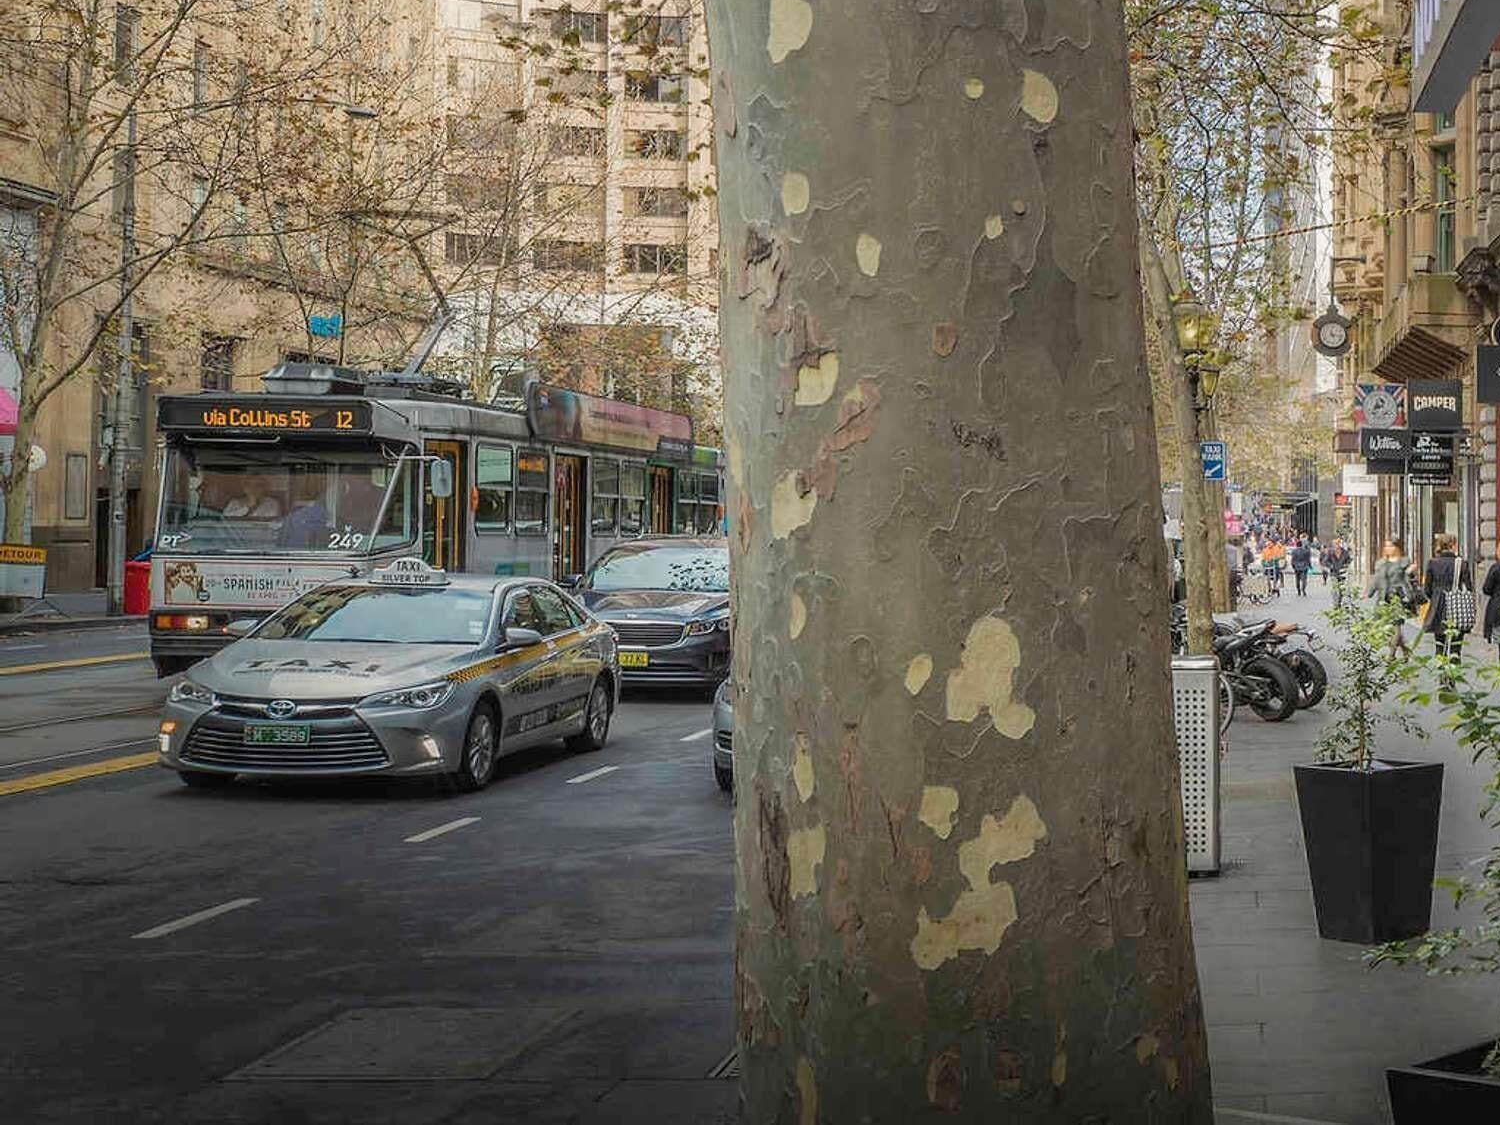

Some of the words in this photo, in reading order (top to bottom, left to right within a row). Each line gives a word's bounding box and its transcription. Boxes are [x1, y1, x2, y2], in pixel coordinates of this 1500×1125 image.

[1413, 396, 1456, 412] CAMPER
[203, 409, 226, 427] via
[229, 408, 286, 428] Collins
[290, 410, 311, 428] St
[336, 410, 353, 429] 12
[328, 533, 363, 550] 249
[0, 550, 41, 559] ETOUR
[396, 560, 421, 572] TAXI
[223, 577, 274, 591] SPANISH
